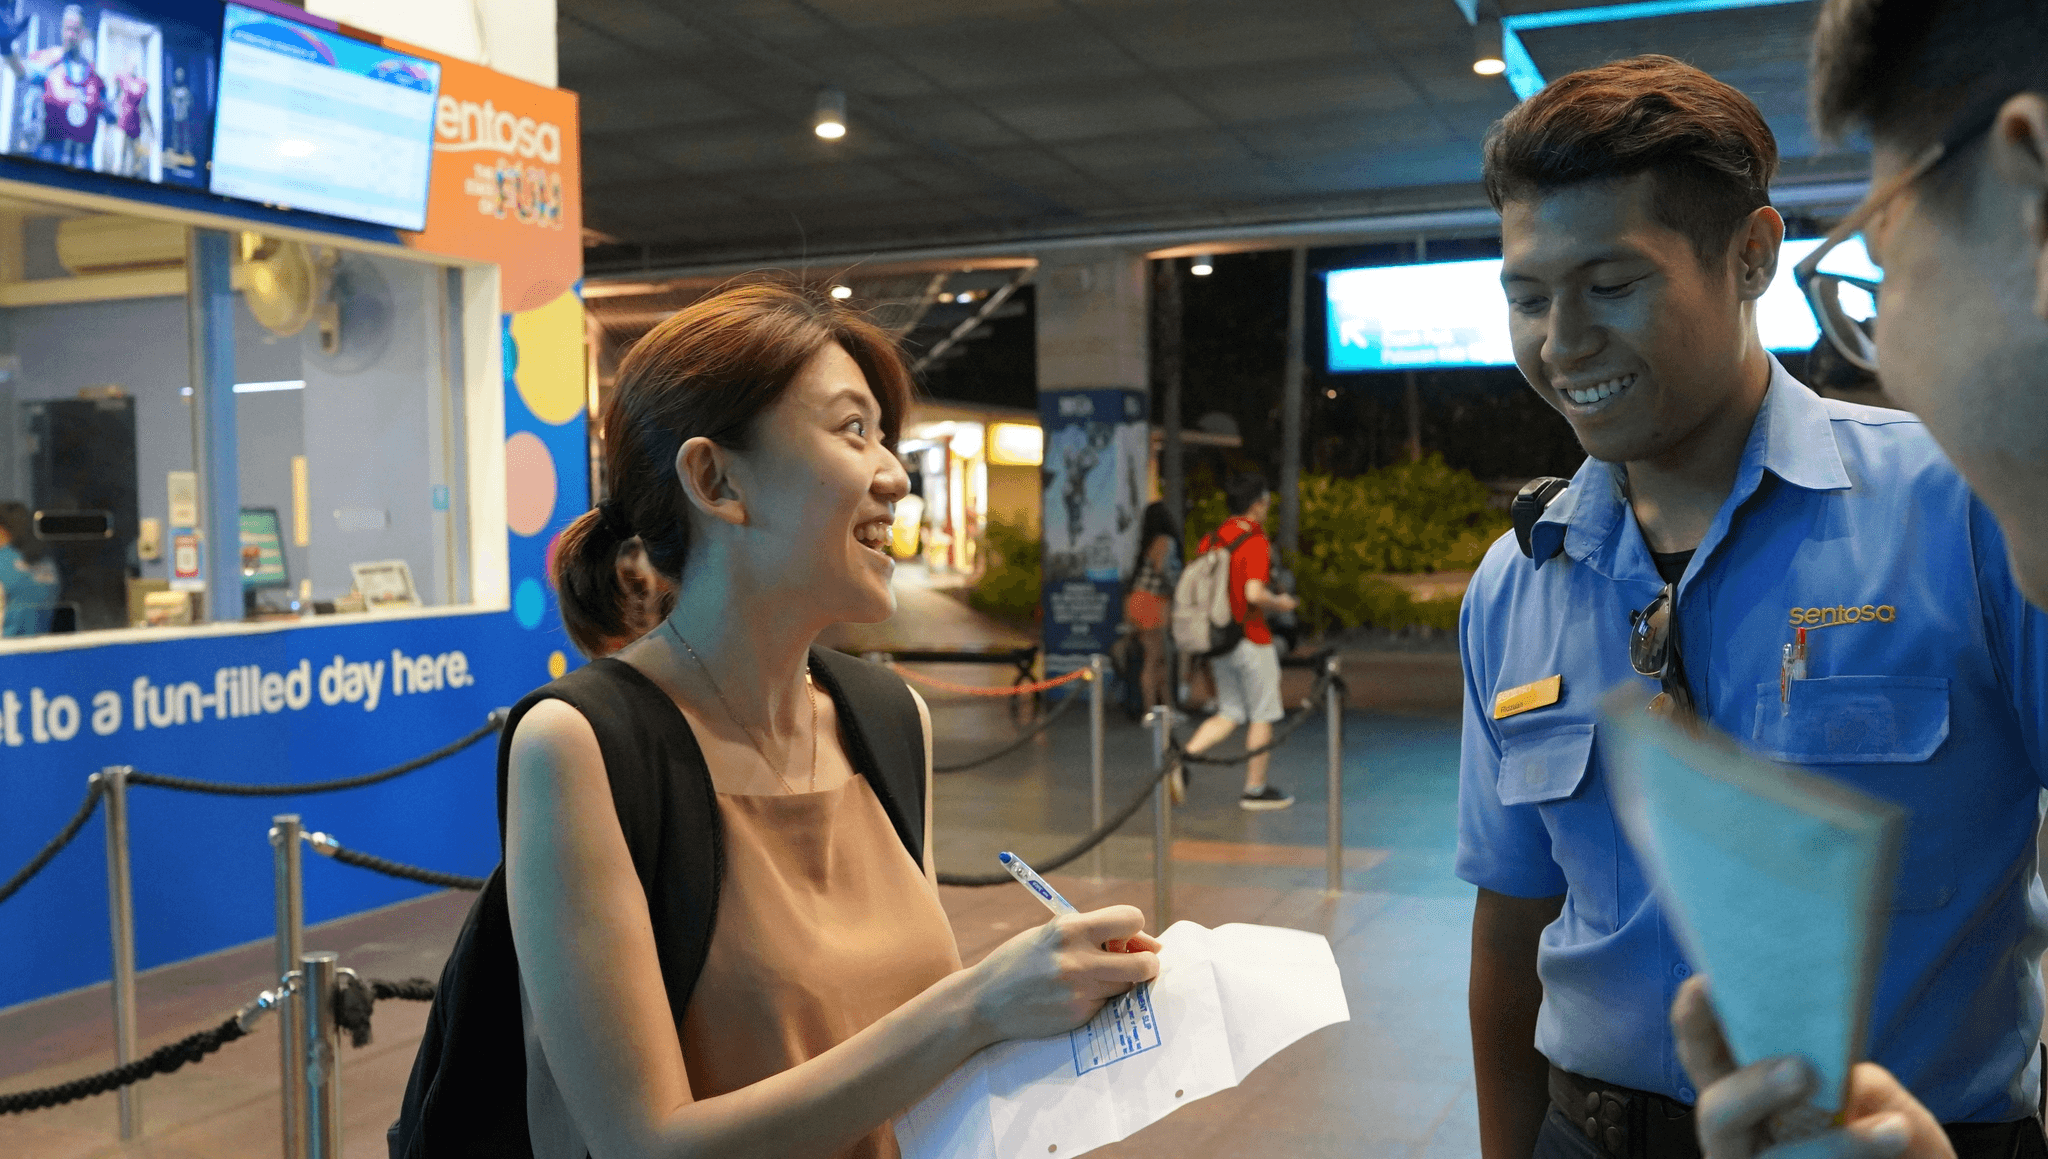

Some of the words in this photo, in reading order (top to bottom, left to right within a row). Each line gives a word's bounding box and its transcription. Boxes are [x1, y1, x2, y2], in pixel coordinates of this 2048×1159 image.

[436, 94, 561, 164] entosa
[1788, 604, 1896, 630] sentosa
[0, 689, 24, 747] t
[30, 687, 82, 743] to
[91, 689, 122, 736] a
[132, 658, 312, 732] fun-filled
[318, 654, 386, 713] day
[391, 648, 475, 697] here.
